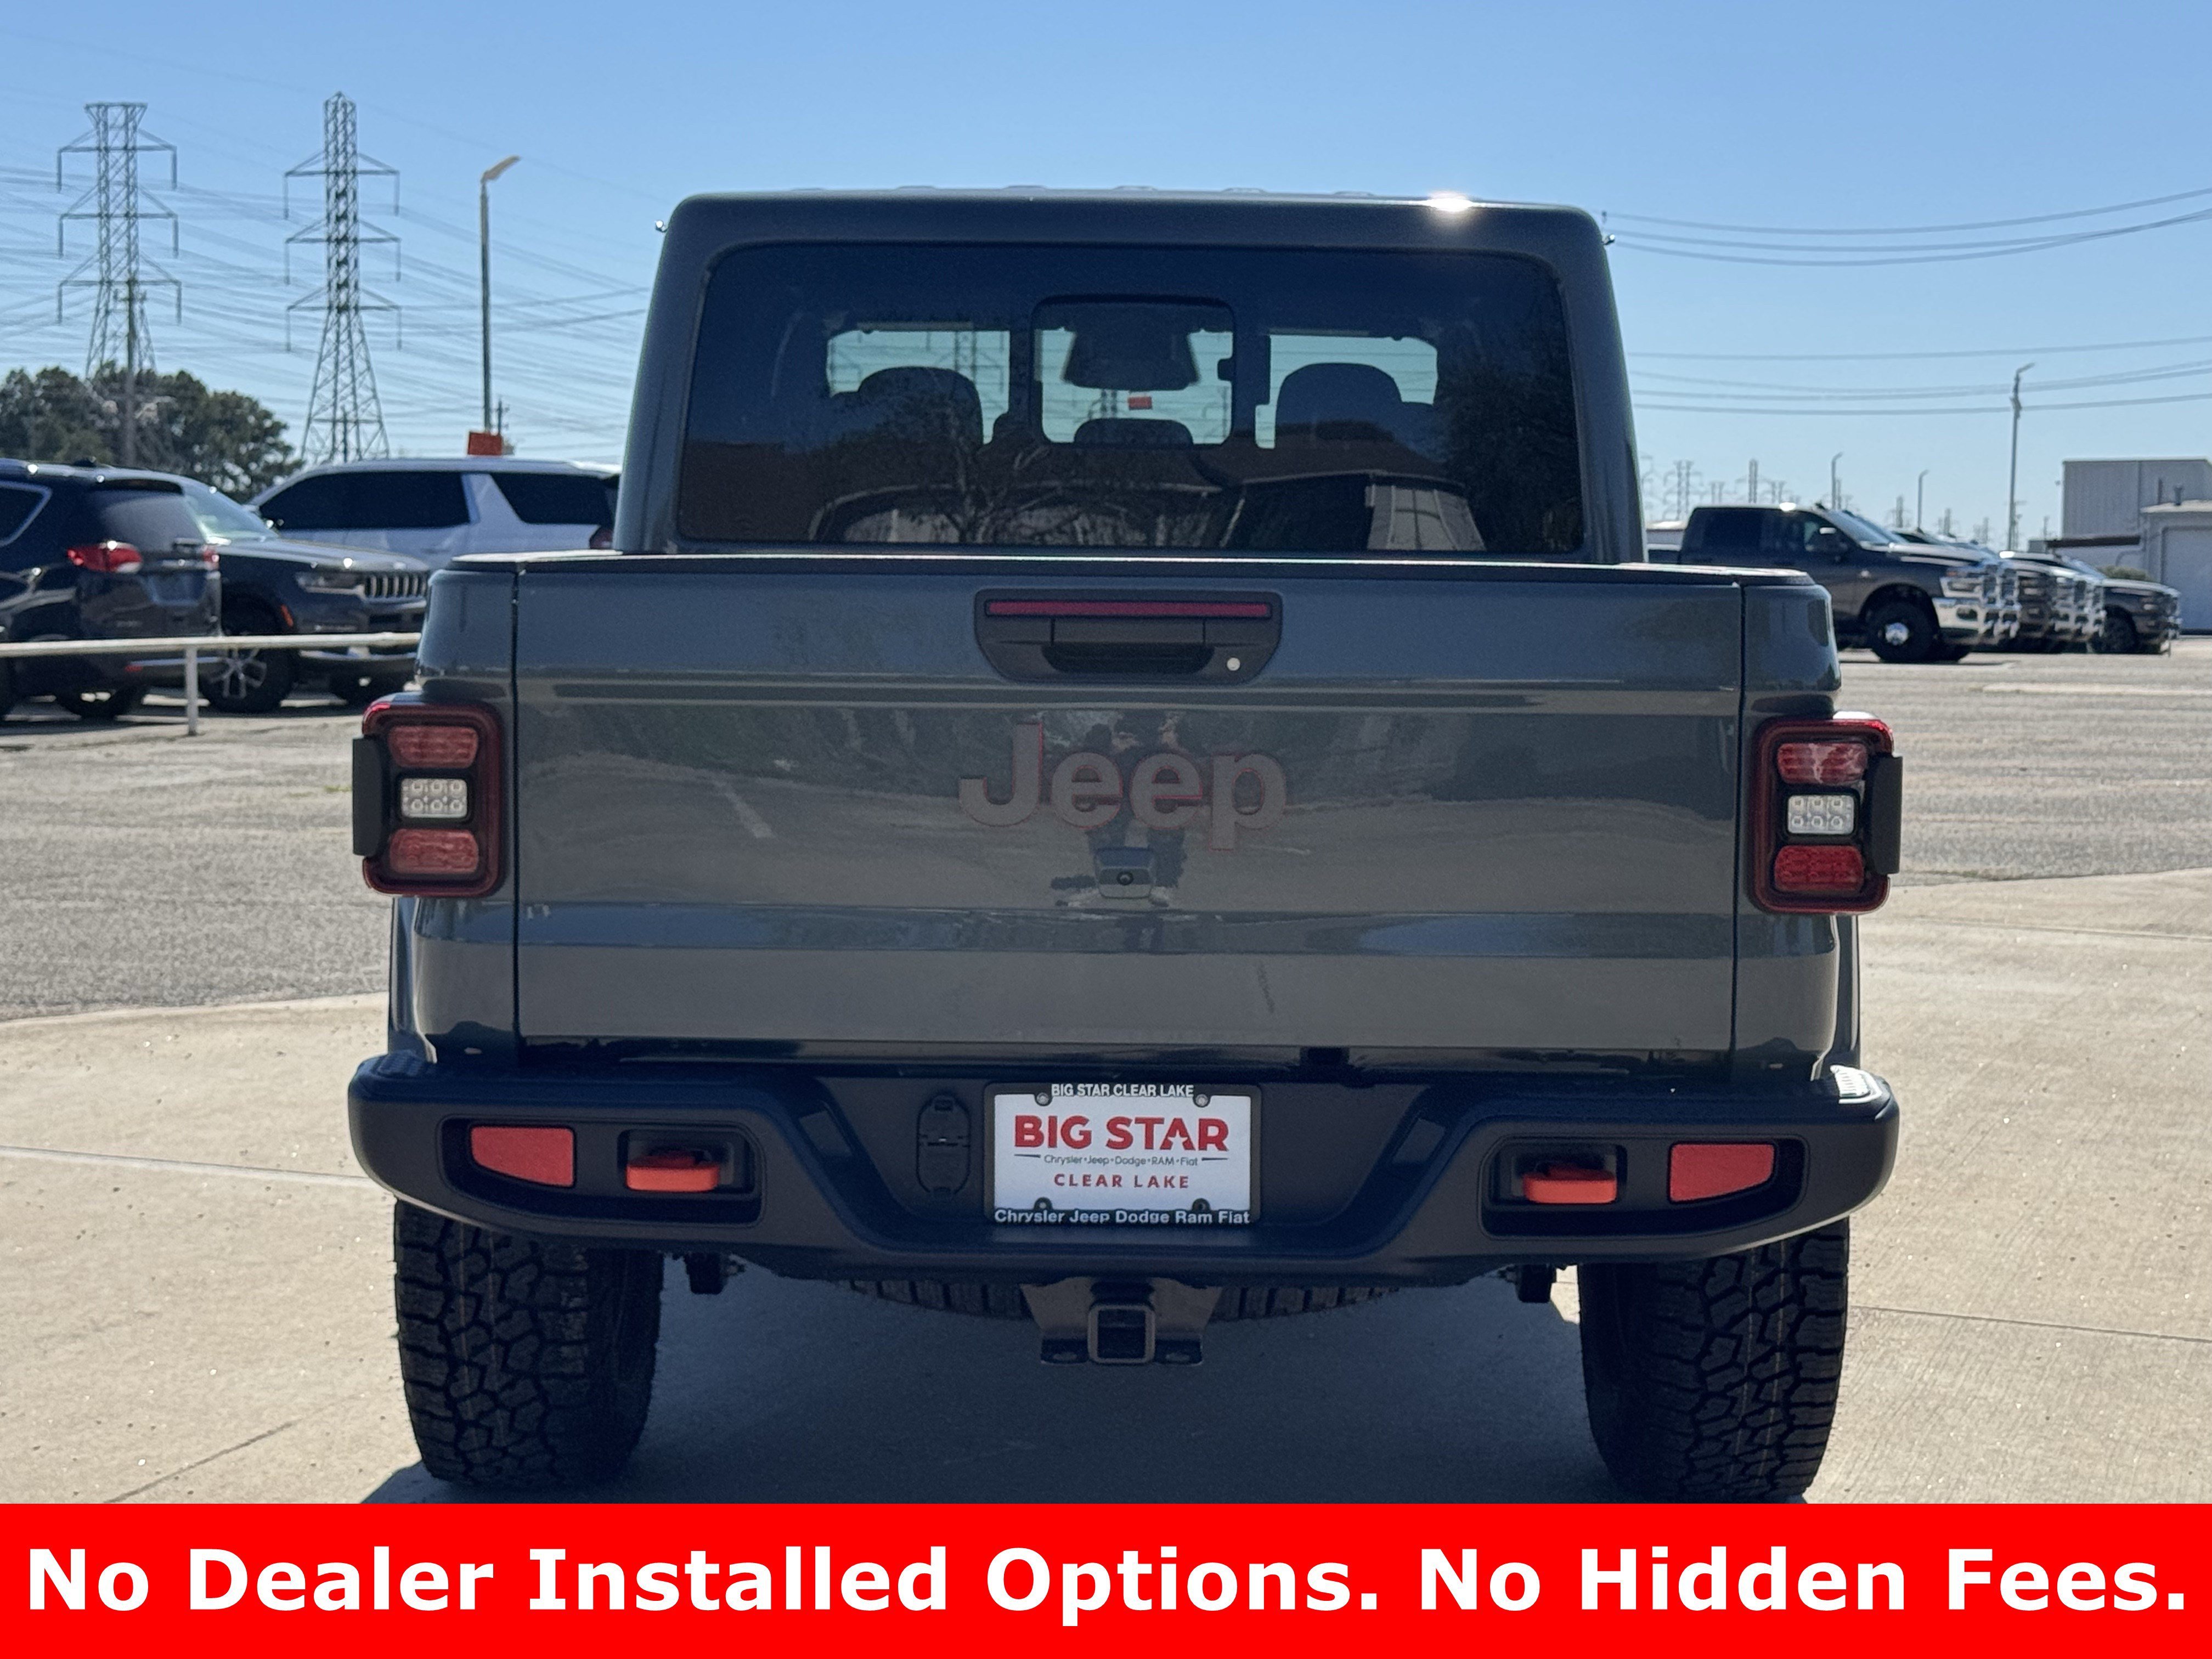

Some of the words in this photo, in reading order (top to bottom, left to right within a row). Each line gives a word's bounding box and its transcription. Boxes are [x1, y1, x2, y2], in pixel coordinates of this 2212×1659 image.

[958, 722, 1286, 851] Jeep
[1052, 1084, 1074, 1096] BIG
[1077, 1084, 1110, 1096] STAR
[1113, 1084, 1156, 1097] CLEAR
[1160, 1085, 1194, 1097] LAKE
[1014, 1115, 1092, 1149] BIG
[1105, 1116, 1229, 1151] STAR
[1054, 1173, 1122, 1187] CLEAR
[1134, 1175, 1188, 1188] LAKE
[994, 1209, 1064, 1224] Chrysler
[1070, 1210, 1110, 1224] Jeep
[1115, 1210, 1169, 1224] Dodge
[1176, 1210, 1212, 1223] Ram
[1218, 1210, 1249, 1223] Fiat
